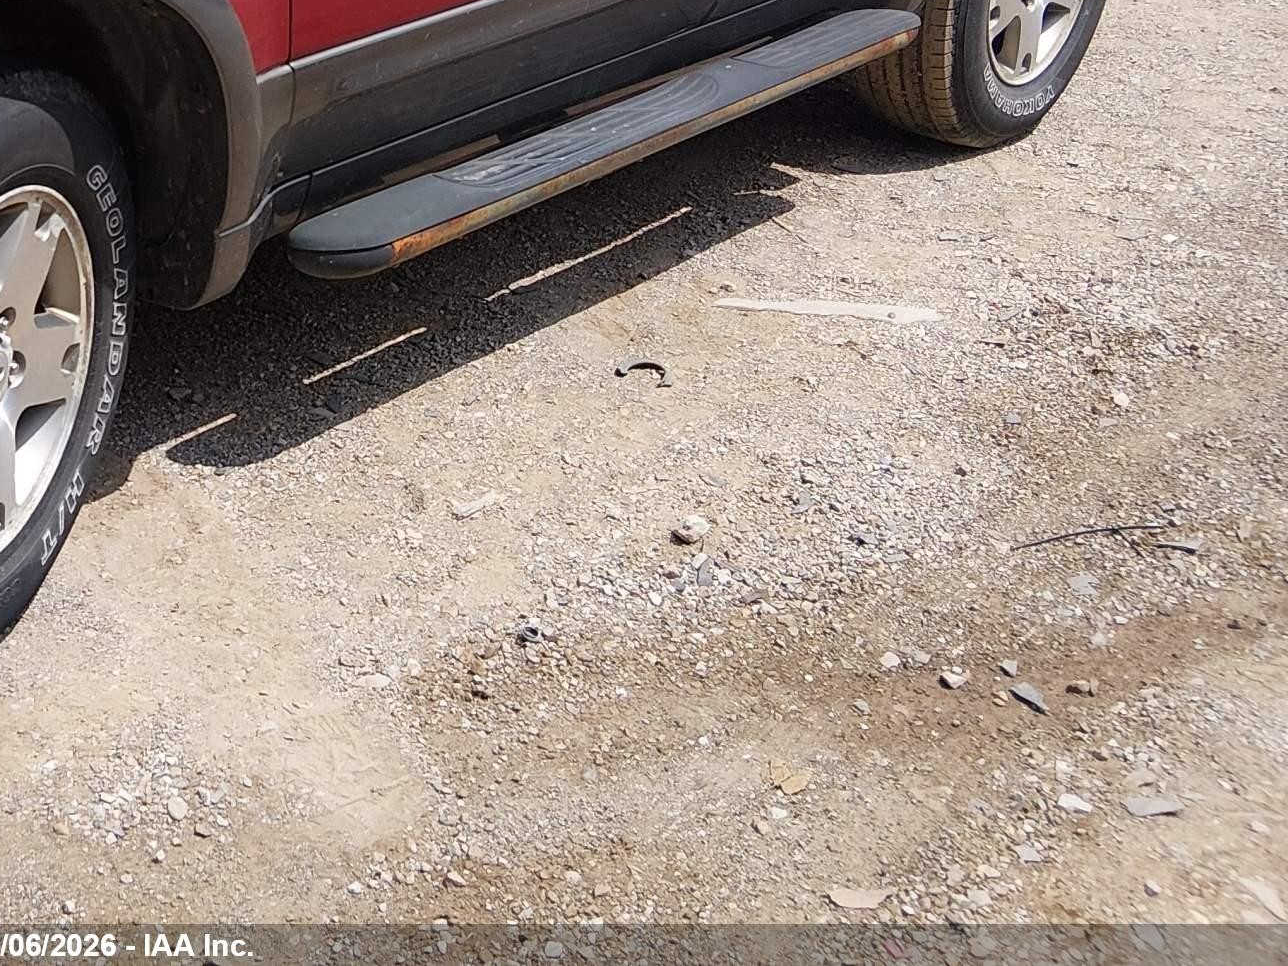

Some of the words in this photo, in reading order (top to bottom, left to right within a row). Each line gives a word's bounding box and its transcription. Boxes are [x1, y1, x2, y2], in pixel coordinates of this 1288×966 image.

[983, 61, 1055, 117] YOKOHAMA
[85, 164, 130, 455] GEOLANDAR
[40, 467, 85, 566] H/T
